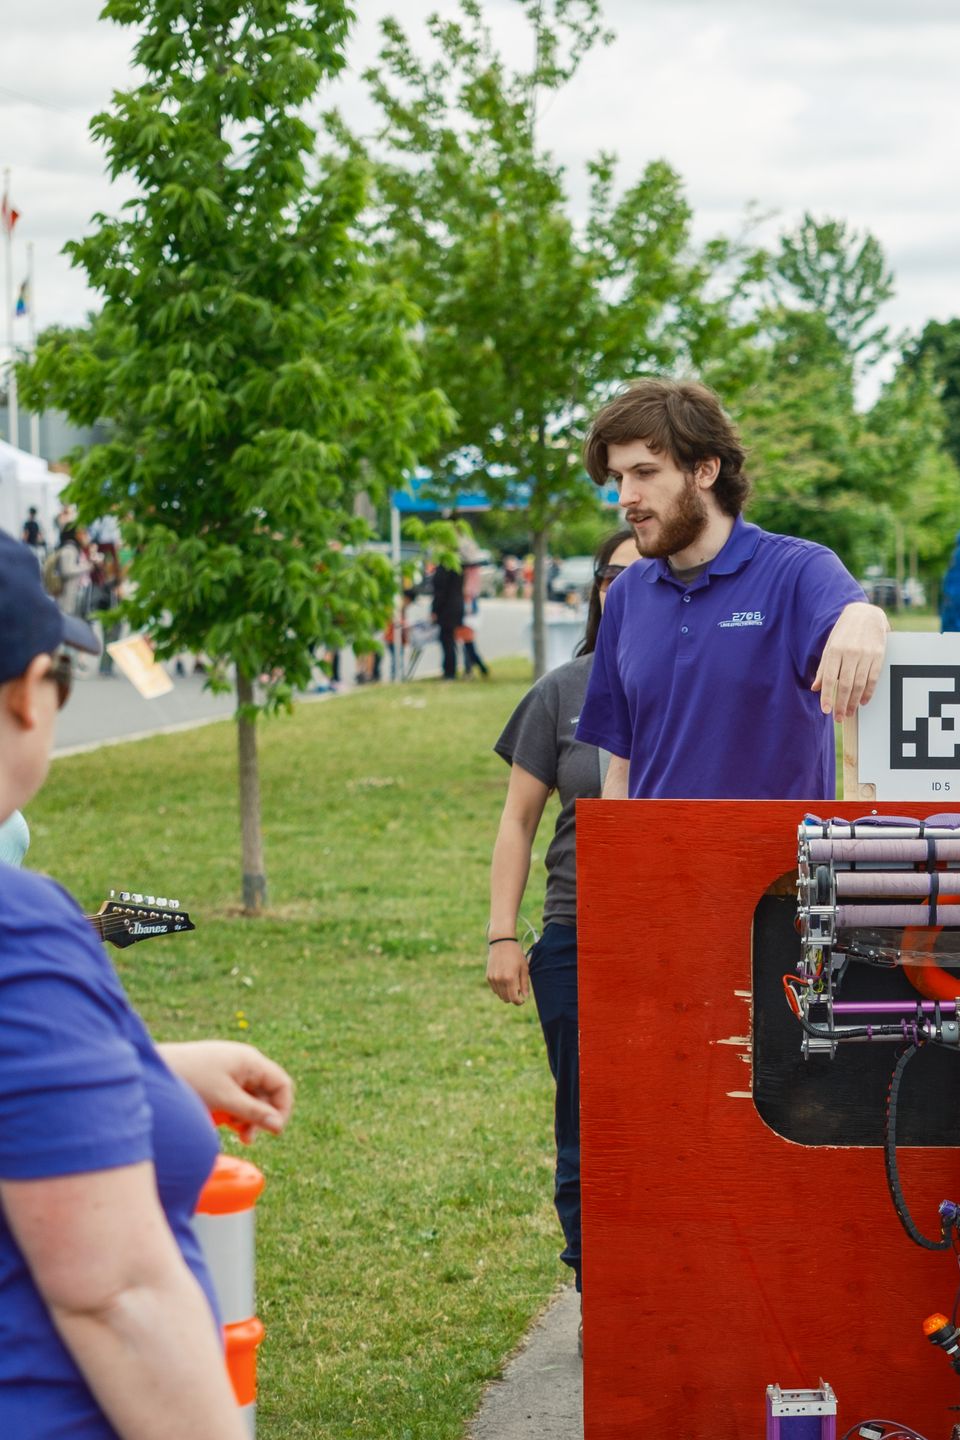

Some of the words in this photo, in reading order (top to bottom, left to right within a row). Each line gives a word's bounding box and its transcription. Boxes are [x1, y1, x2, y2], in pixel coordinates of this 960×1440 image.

[732, 611, 761, 621] 2708
[932, 782, 942, 791] ID
[944, 782, 951, 791] 5
[133, 922, 168, 934] Ibanez
